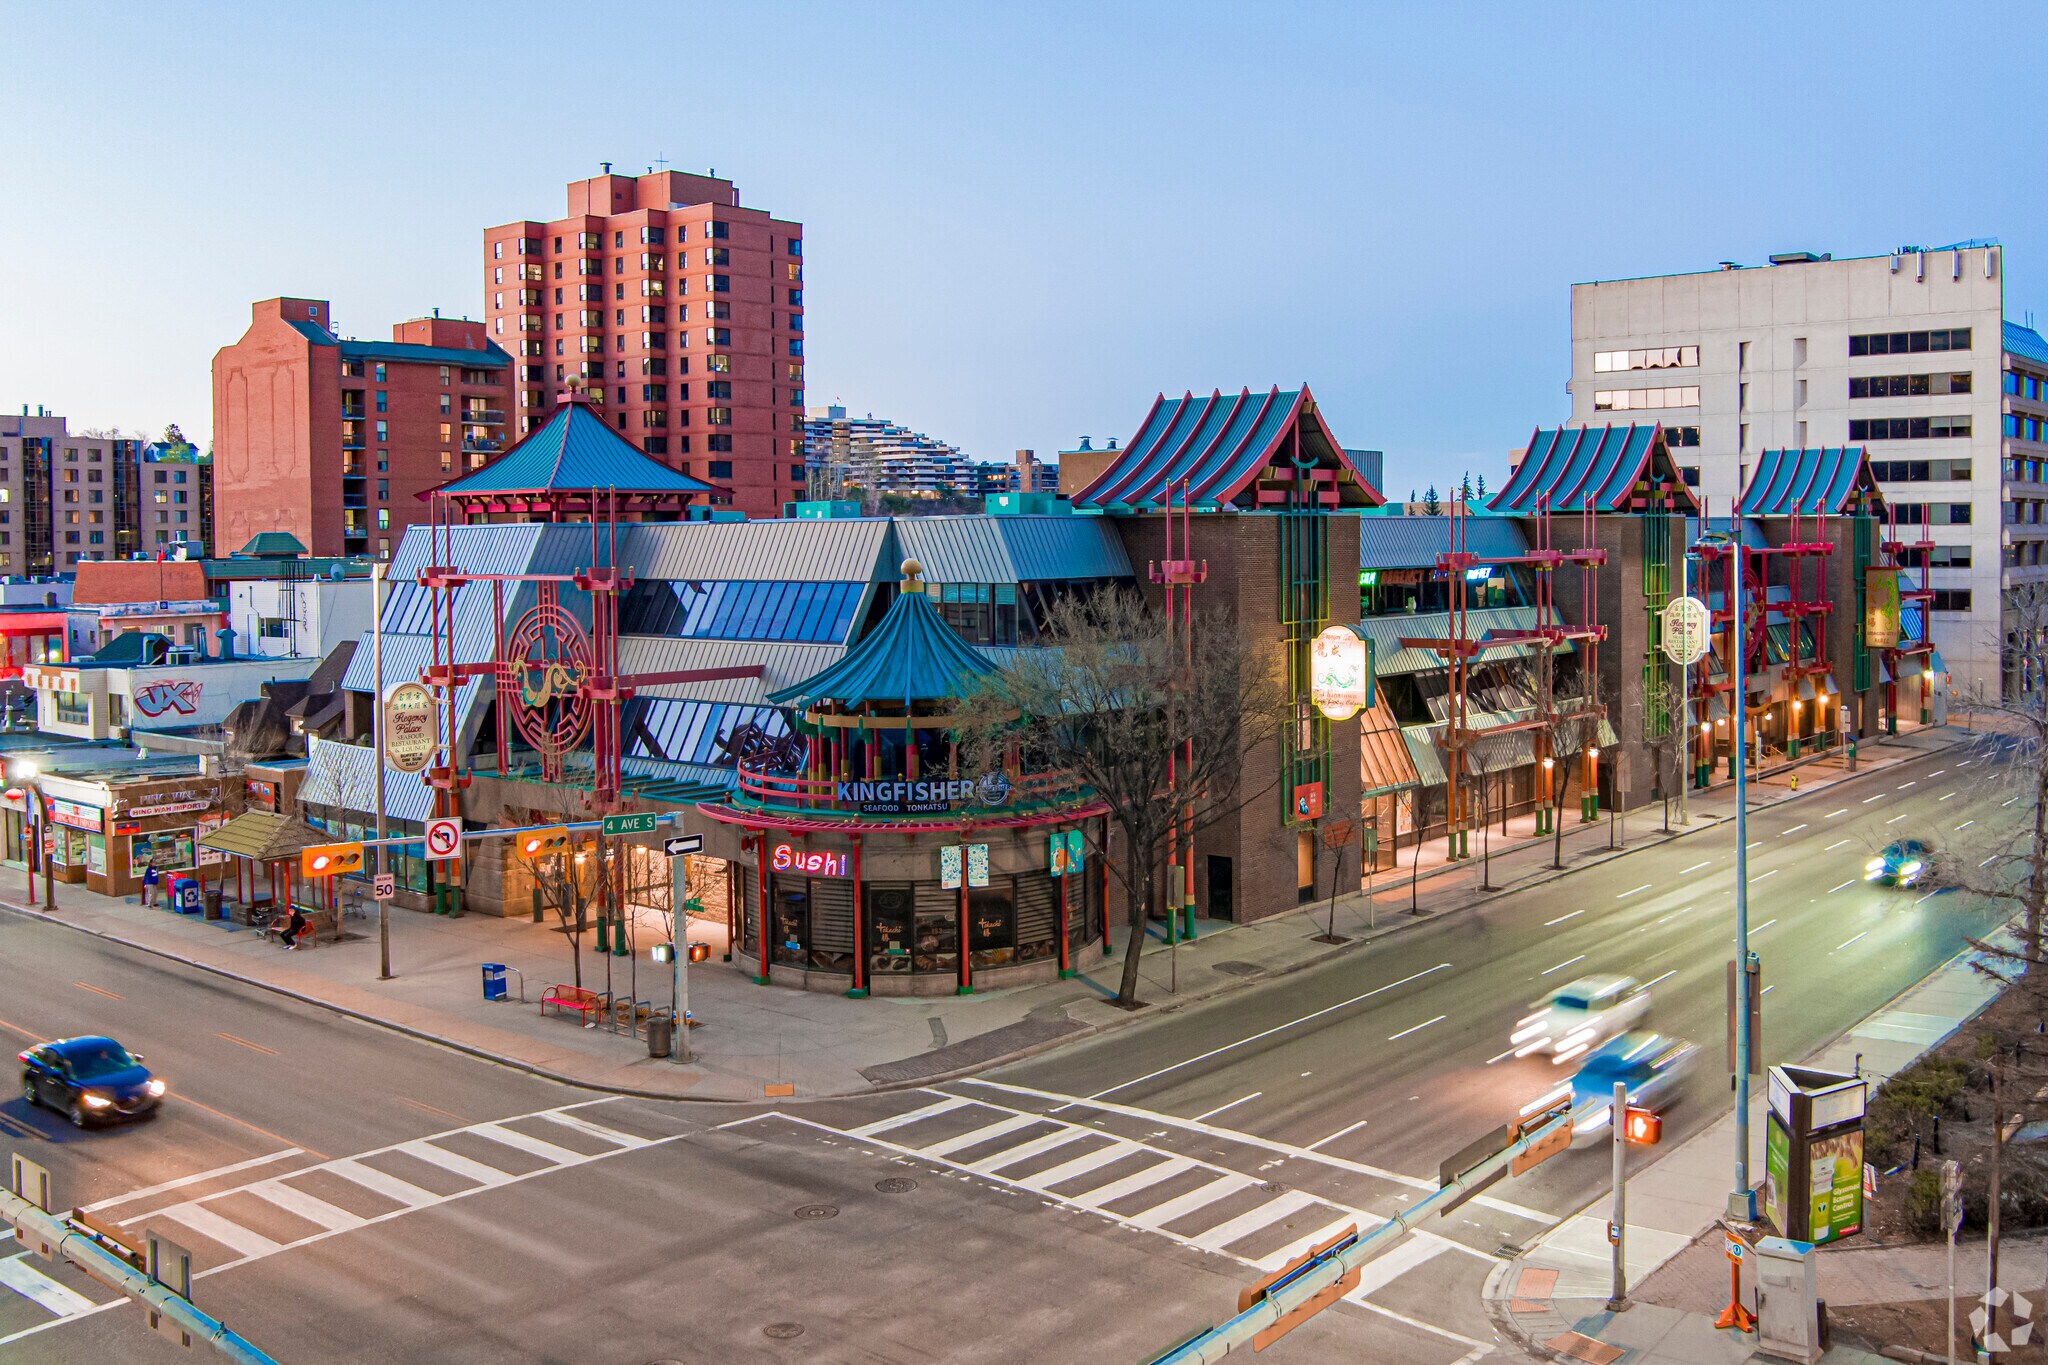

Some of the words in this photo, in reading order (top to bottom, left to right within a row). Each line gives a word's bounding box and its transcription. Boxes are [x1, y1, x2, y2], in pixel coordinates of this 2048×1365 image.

[393, 712, 428, 725] Regency
[396, 723, 422, 734] Palace
[391, 738, 431, 747] RESTAURANT
[837, 780, 974, 801] KINGFISHER
[132, 808, 152, 816] HING
[154, 804, 172, 813] WAH
[174, 800, 207, 811] IMPORTS
[863, 804, 899, 812] SEAFOOD
[907, 803, 948, 812] TONKATSU
[606, 820, 614, 831] 4
[620, 818, 640, 830] AVE
[646, 817, 653, 828] S
[773, 844, 846, 876] Sushi
[376, 883, 393, 897] 50
[1832, 1200, 1854, 1212] Control
